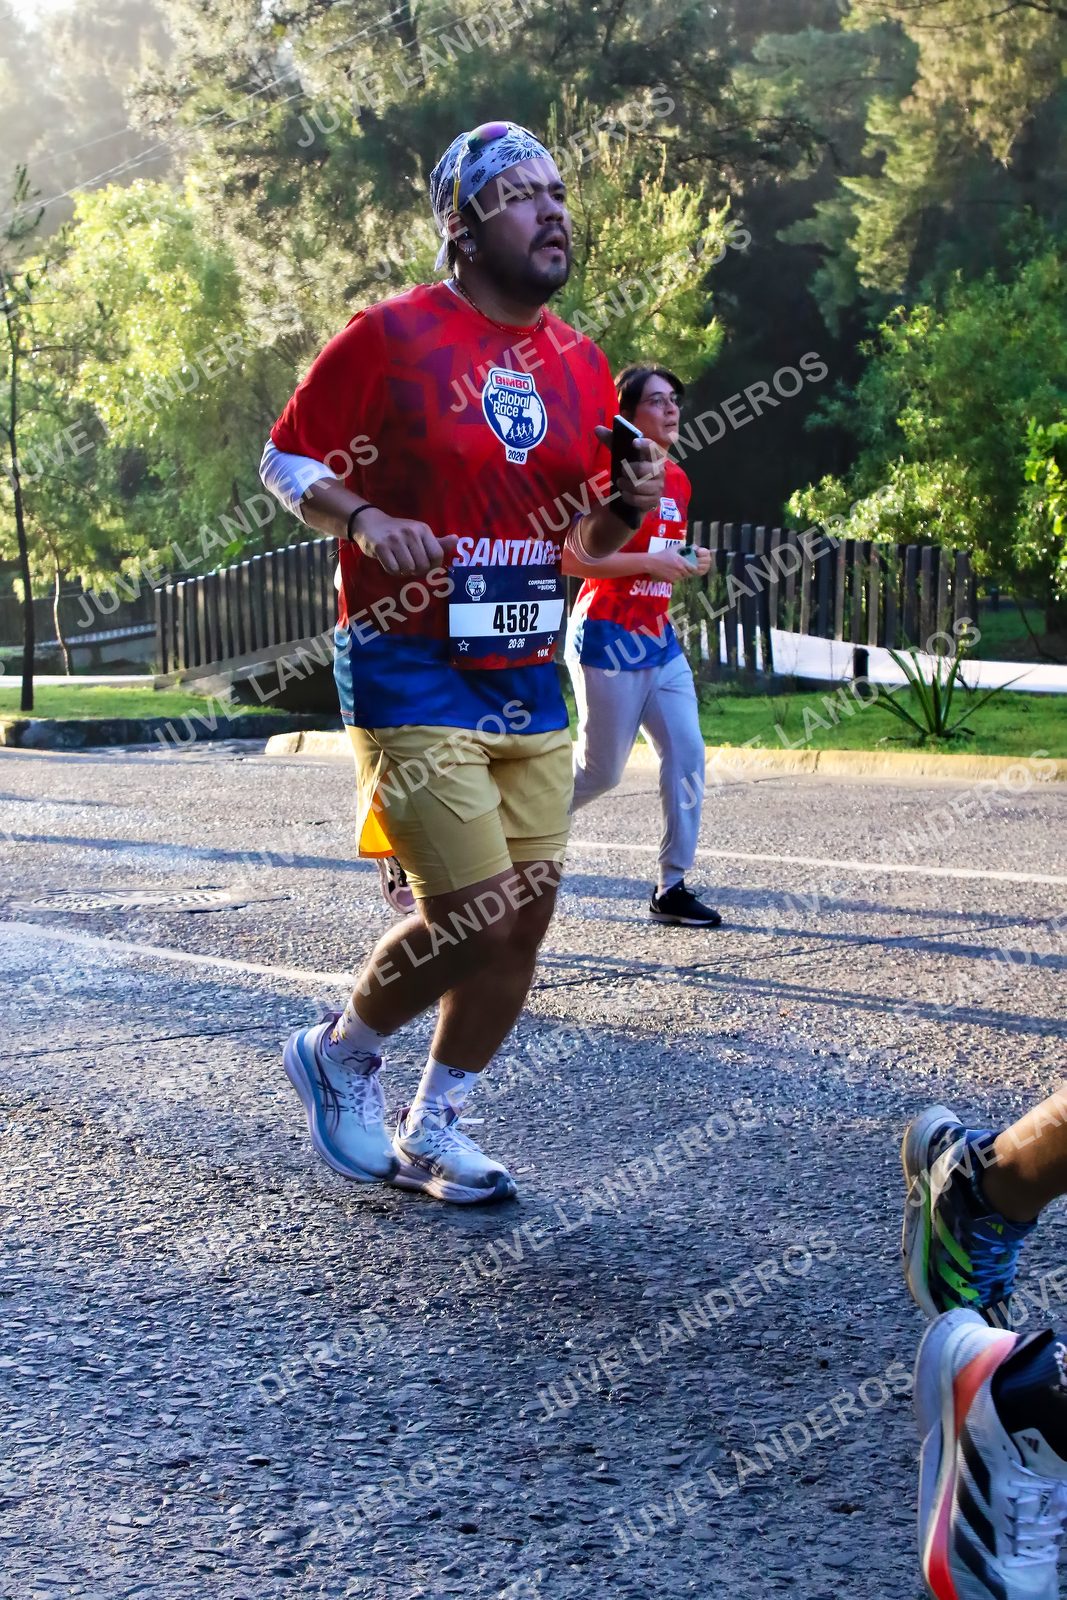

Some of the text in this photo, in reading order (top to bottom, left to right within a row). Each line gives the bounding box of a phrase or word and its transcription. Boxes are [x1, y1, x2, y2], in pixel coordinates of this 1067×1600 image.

[495, 375, 530, 390] BIMBO
[498, 390, 530, 409] Global
[493, 402, 519, 417] Race
[507, 449, 526, 462] 2026
[493, 603, 540, 633] 4582
[537, 648, 549, 658] 10K
